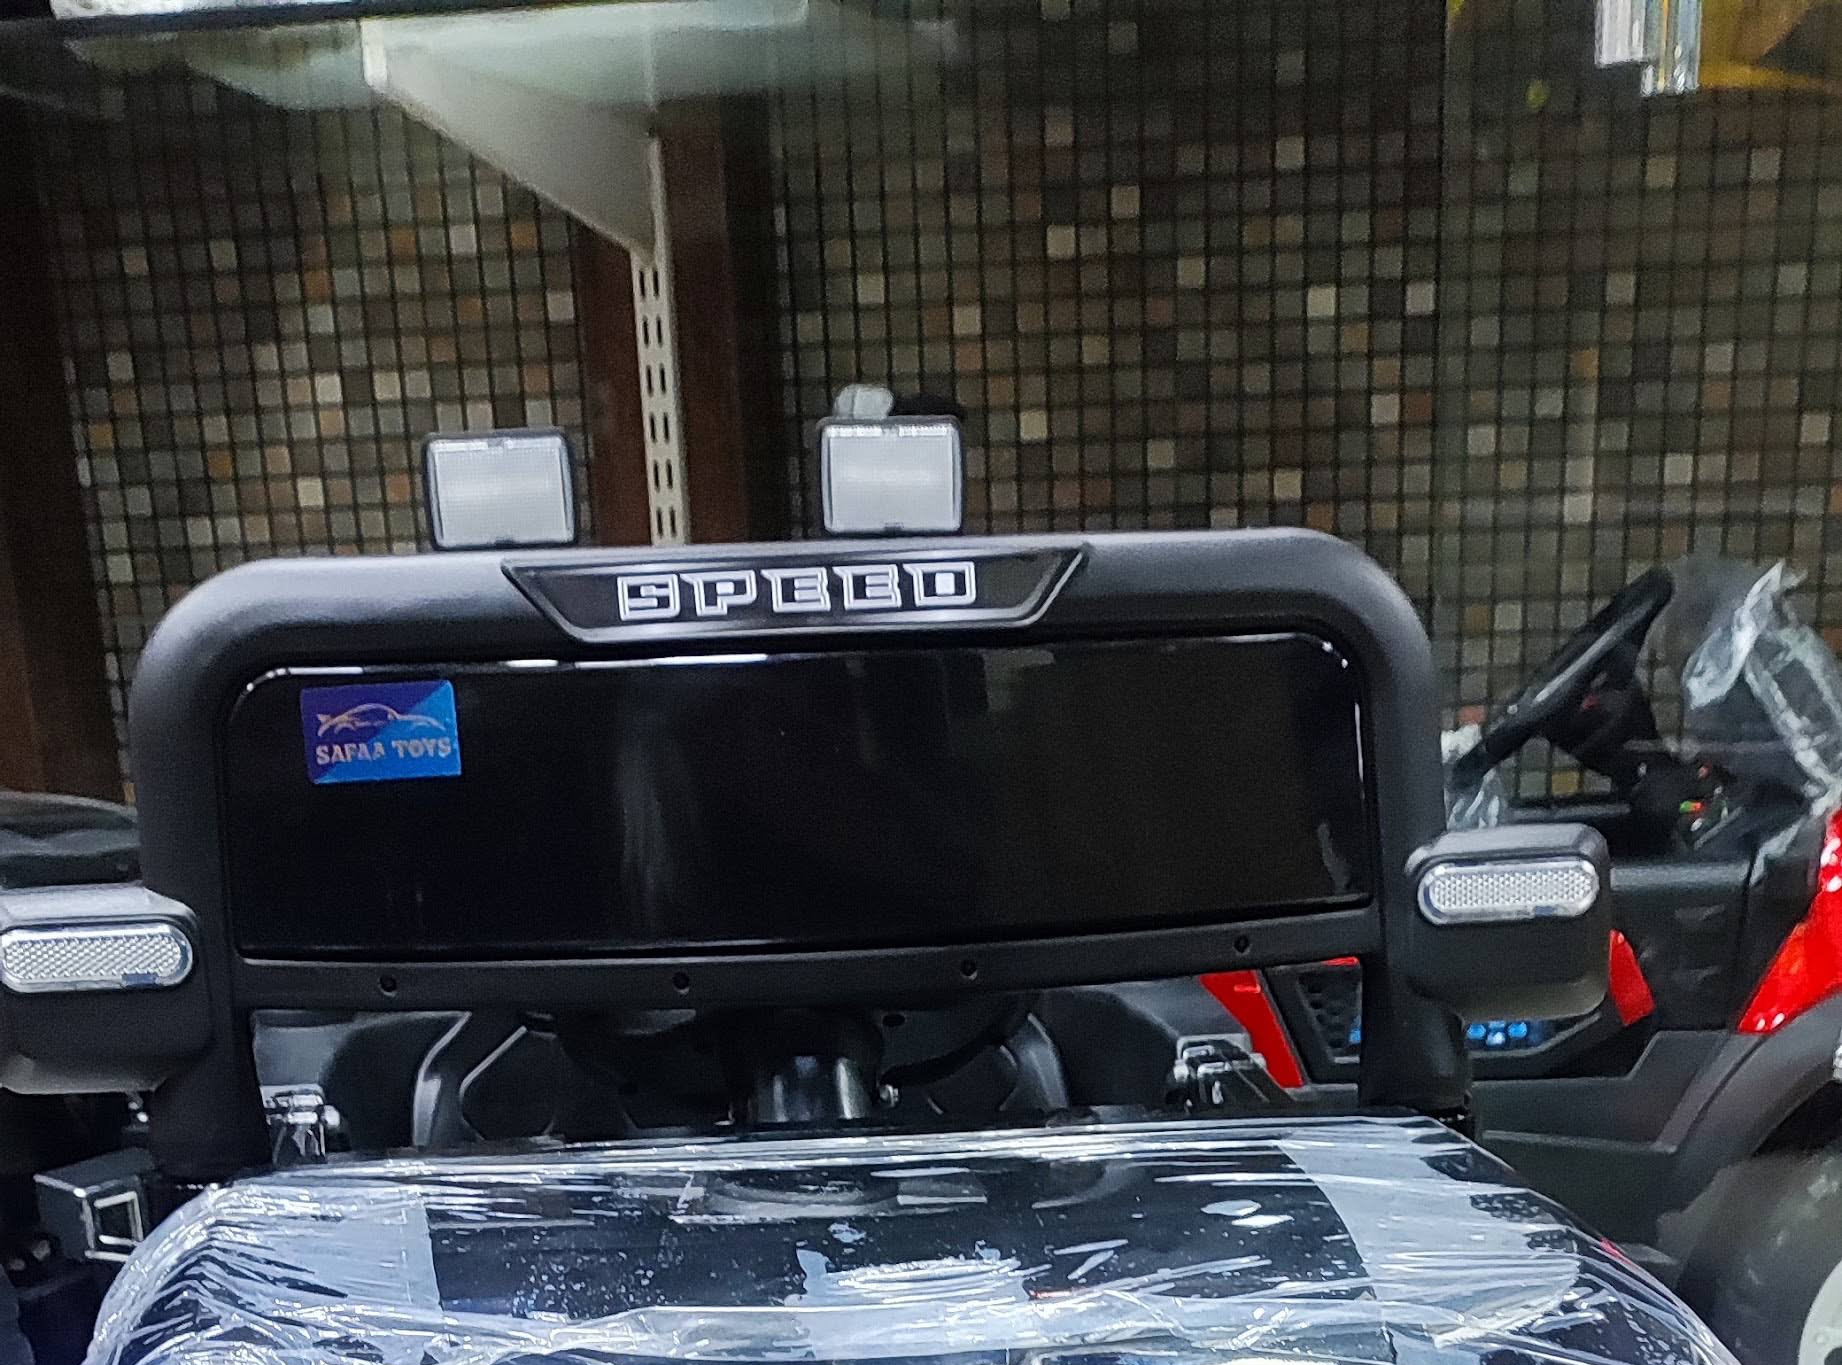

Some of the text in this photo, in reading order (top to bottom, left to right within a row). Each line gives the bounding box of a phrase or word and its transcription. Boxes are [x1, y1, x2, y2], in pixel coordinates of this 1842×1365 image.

[615, 561, 977, 622] SPEED
[315, 737, 452, 765] SAFAA TOYS
